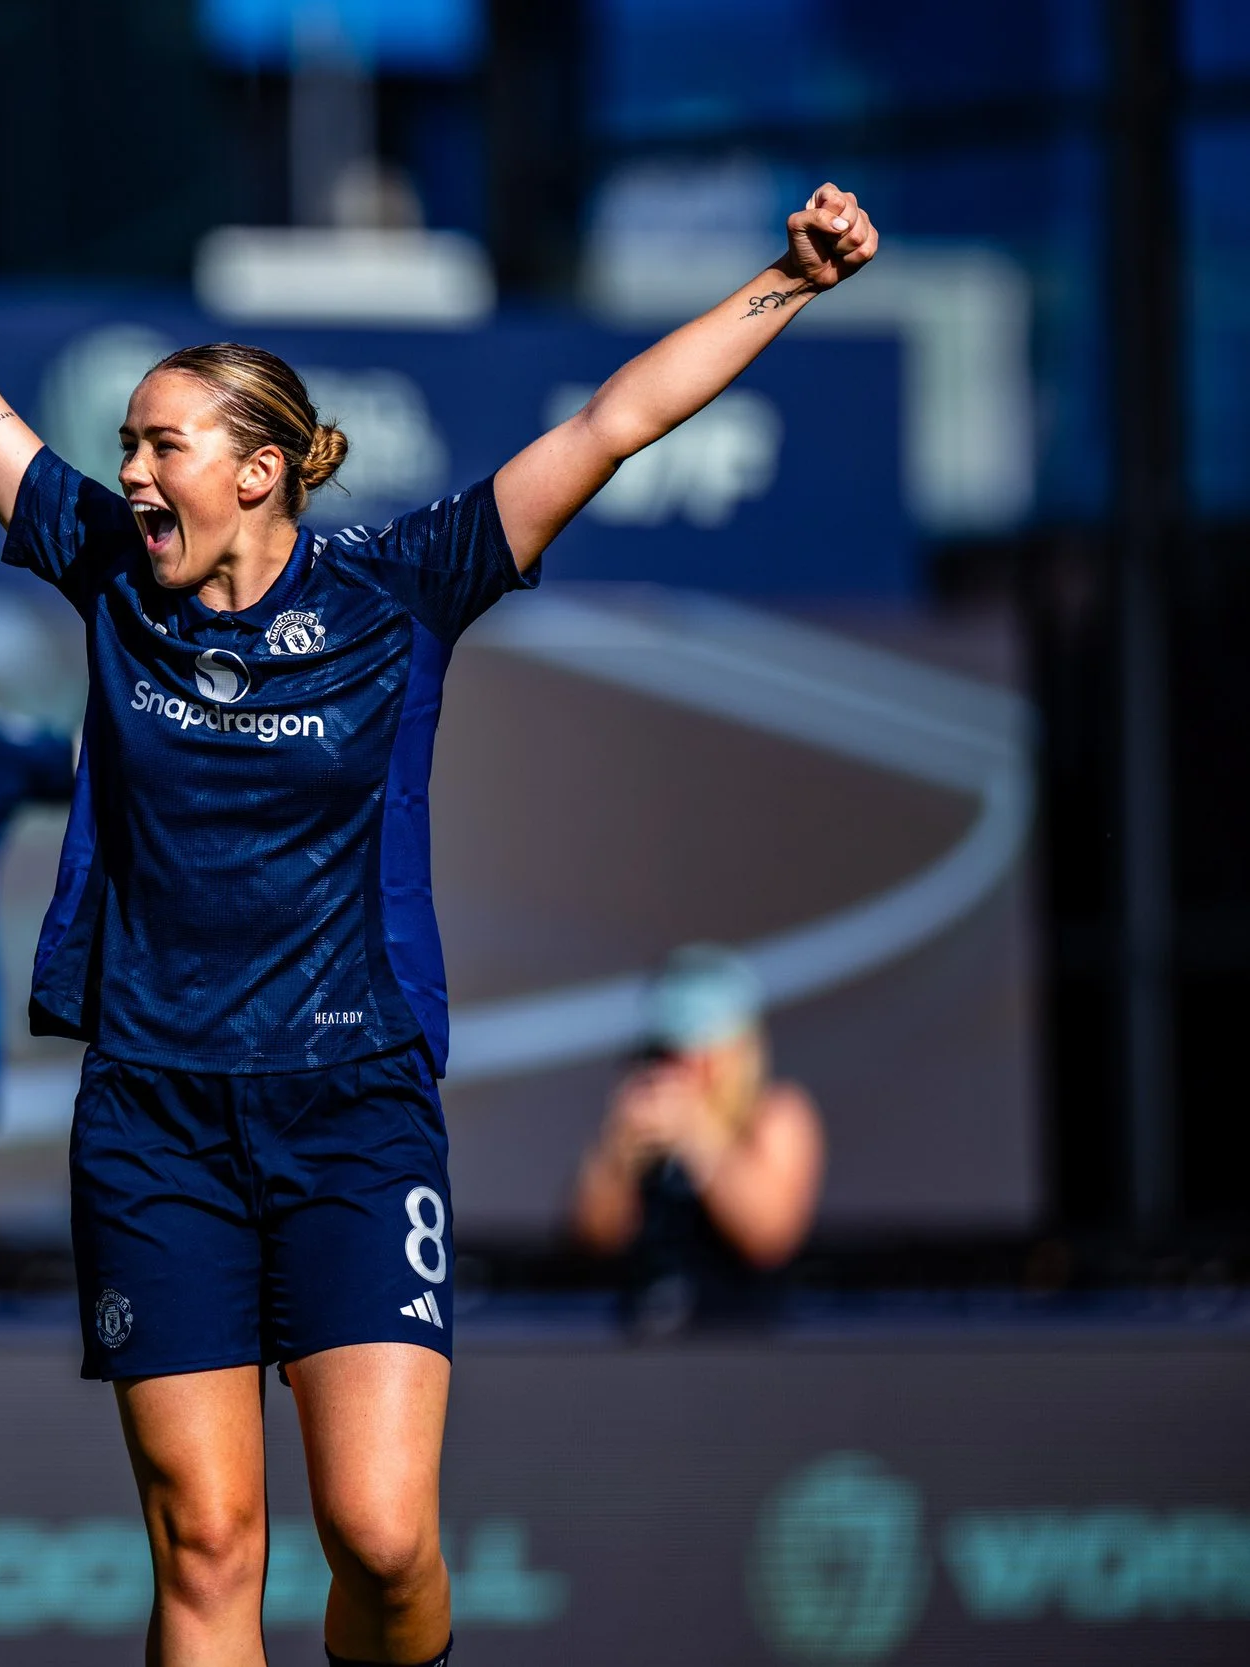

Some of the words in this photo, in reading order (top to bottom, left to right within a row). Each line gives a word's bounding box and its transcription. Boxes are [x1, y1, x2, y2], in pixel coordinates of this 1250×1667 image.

[270, 613, 315, 641] MANCHESTER
[130, 680, 324, 743] Snapdragon
[314, 1011, 363, 1024] HEAT.RDY
[404, 1186, 446, 1284] 8
[104, 1332, 126, 1344] UNITED
